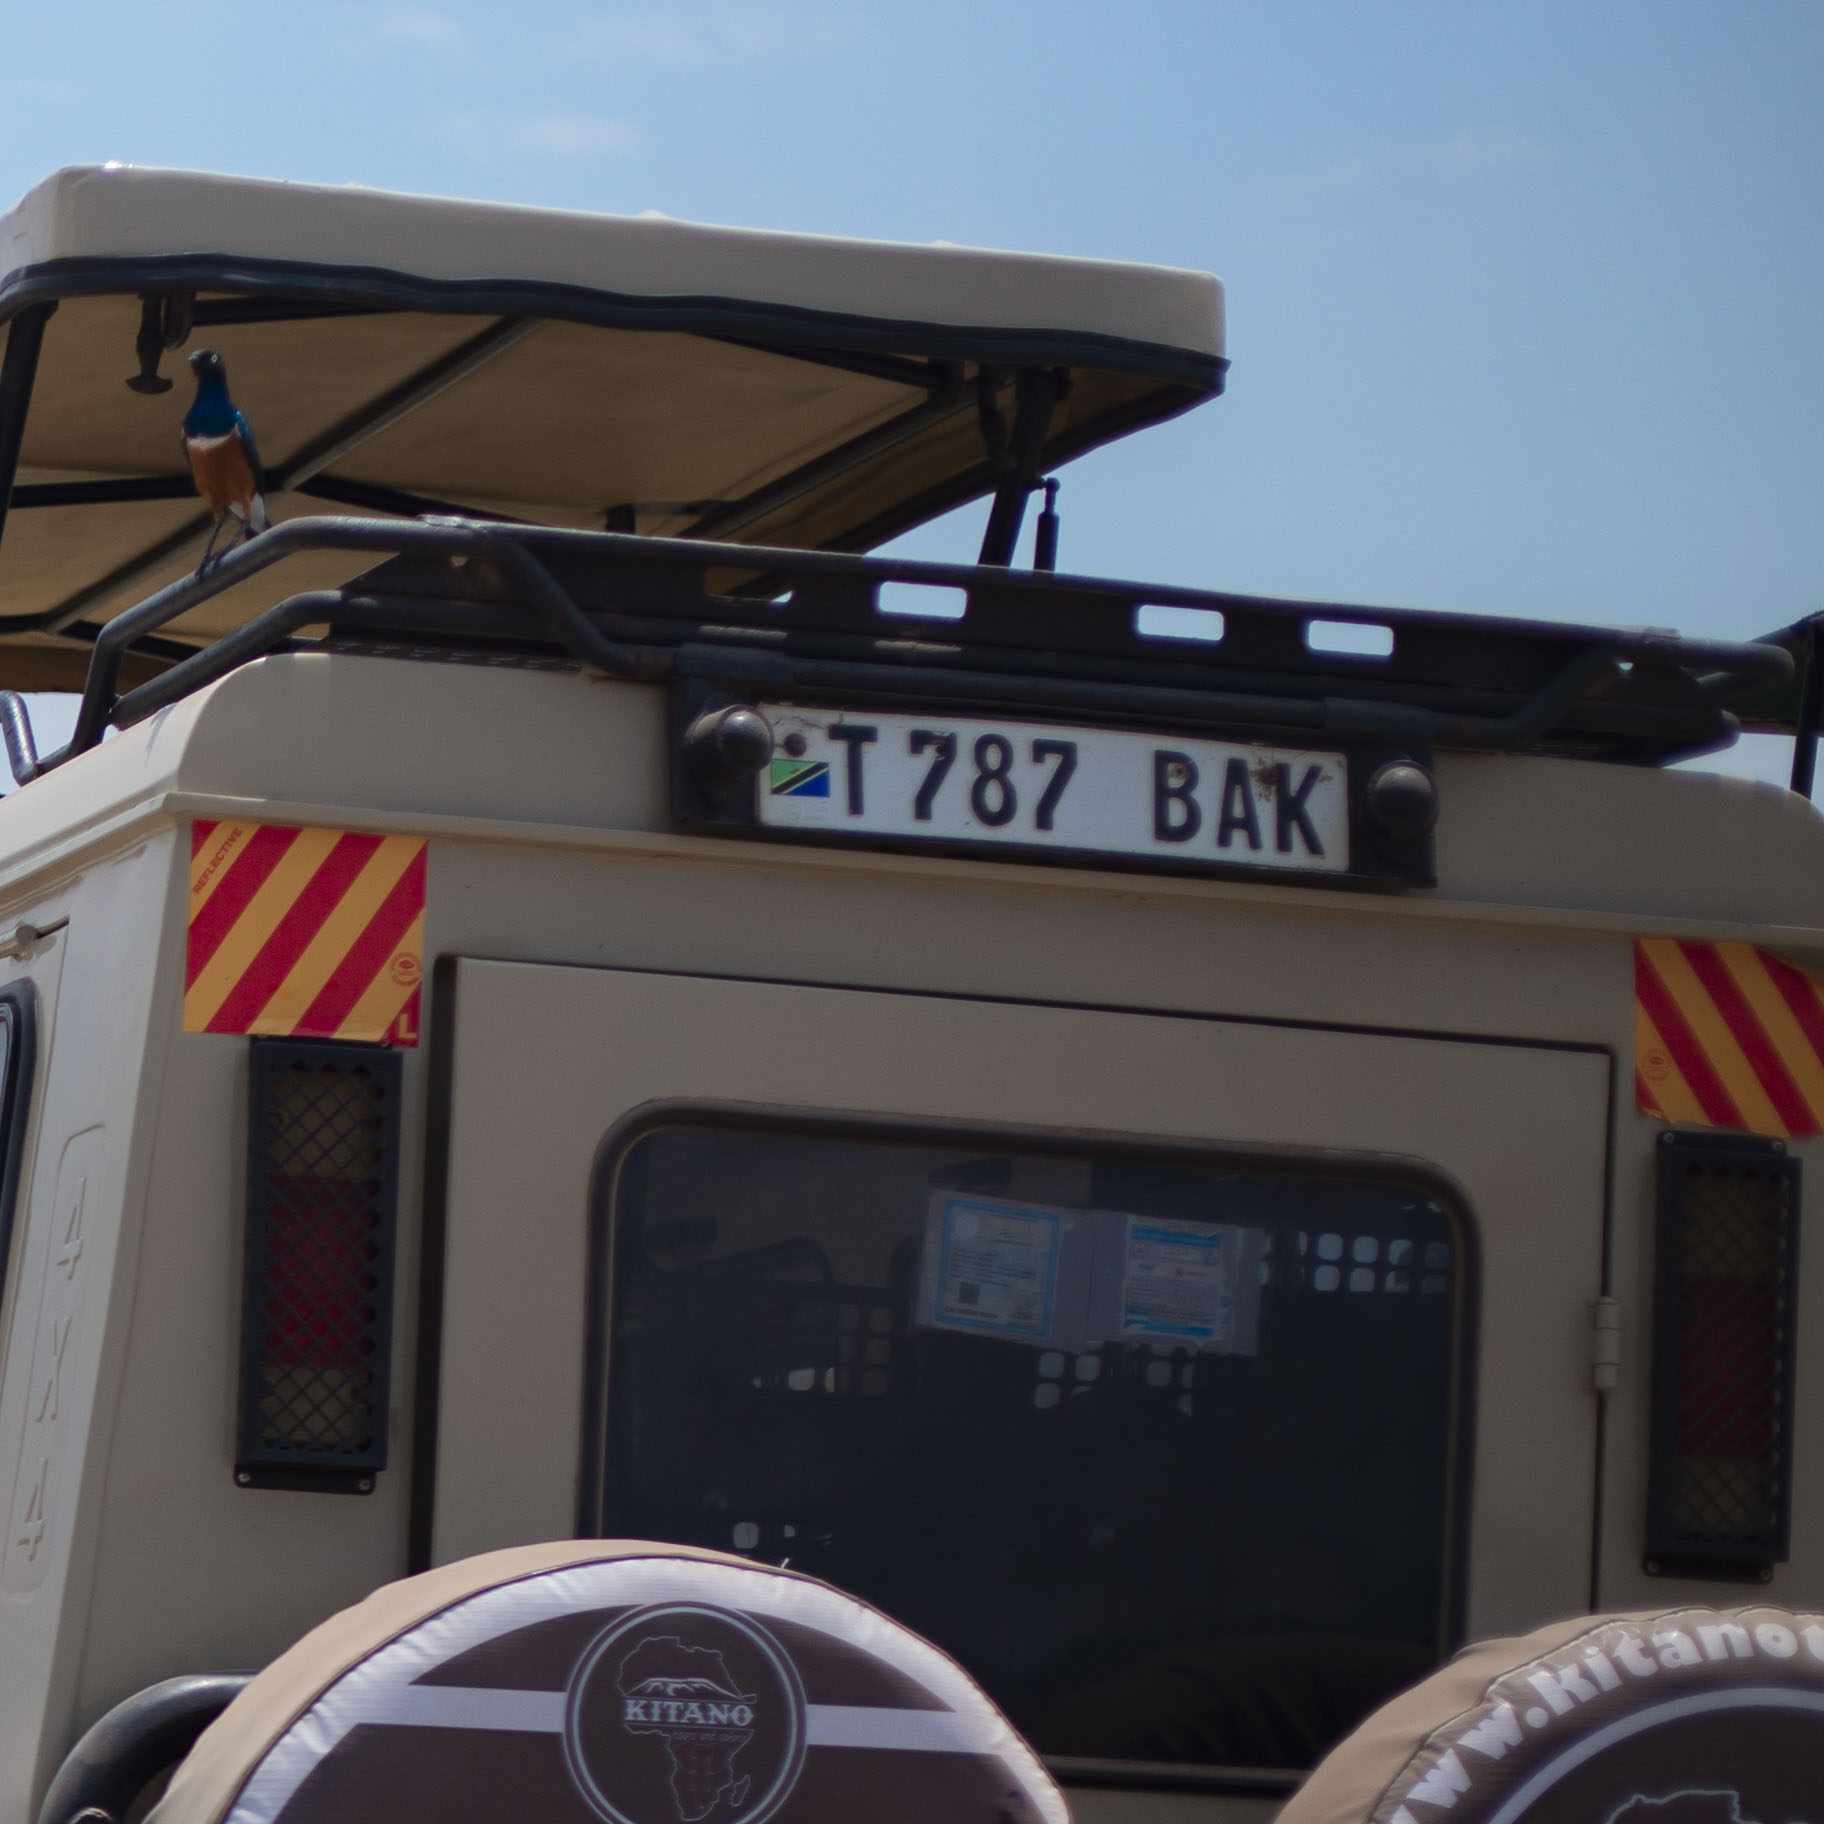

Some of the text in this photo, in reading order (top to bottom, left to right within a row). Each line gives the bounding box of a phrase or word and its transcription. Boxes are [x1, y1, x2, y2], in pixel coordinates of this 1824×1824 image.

[828, 724, 1326, 856] T 787 BAK
[193, 826, 243, 894] REFLECTIVE
[625, 1699, 753, 1726] KITANO
